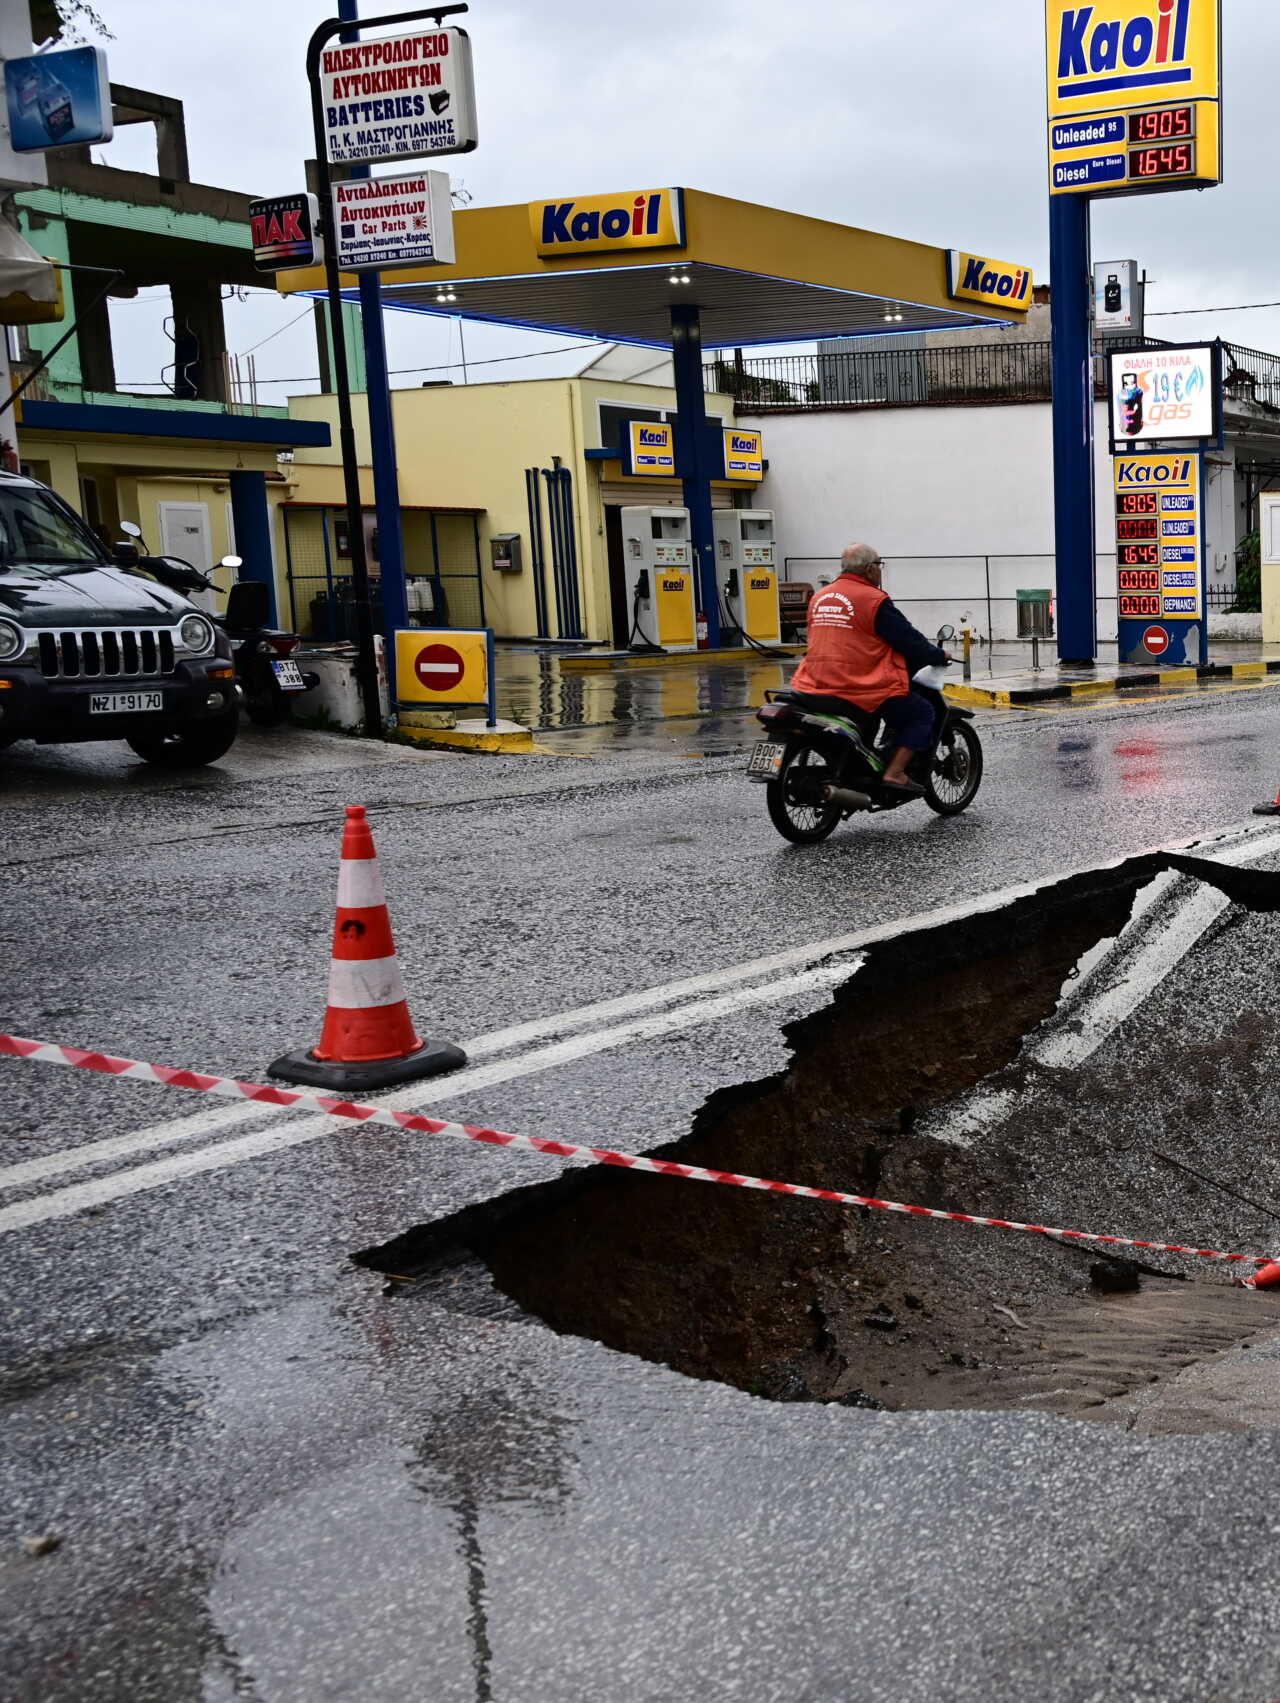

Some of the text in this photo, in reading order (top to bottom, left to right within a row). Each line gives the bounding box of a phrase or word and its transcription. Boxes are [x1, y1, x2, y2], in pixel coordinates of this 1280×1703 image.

[1057, 0, 1190, 78] Kaoil
[323, 33, 449, 74] ΗΛΕΚΤΡΟΛΟΓΕΙΟ
[333, 62, 442, 100] ΑΥΤΟΚΙΝΗΤΩΝ
[327, 94, 425, 128] BATTERIES
[329, 118, 454, 149] Π. Κ. ΜΑΣΤΡΟΓΙΑΝΝΗΣ
[1055, 121, 1117, 145] Unleaded 95
[1139, 109, 1187, 139] 1.905
[349, 146, 369, 159] 24210
[412, 138, 428, 151] 6977
[1139, 146, 1187, 175] 1.645
[1056, 164, 1089, 183] Diesel
[341, 200, 426, 222] Αυτοκινήτων
[542, 194, 662, 244] Kaoil
[362, 220, 407, 235] Car Parts
[962, 258, 1029, 300] Kaoil
[1123, 355, 1192, 369] ΦΙΑΛΗ 10 ΚΙΛΑ
[1145, 403, 1193, 426] gas
[639, 428, 668, 443] Kaoil
[731, 436, 757, 450] Kaoil
[1118, 459, 1191, 483] Kaoil
[1162, 496, 1188, 509] UNLEADED
[663, 578, 685, 590] Kaoil
[751, 578, 770, 589] Kaoil
[752, 757, 772, 770] 603
